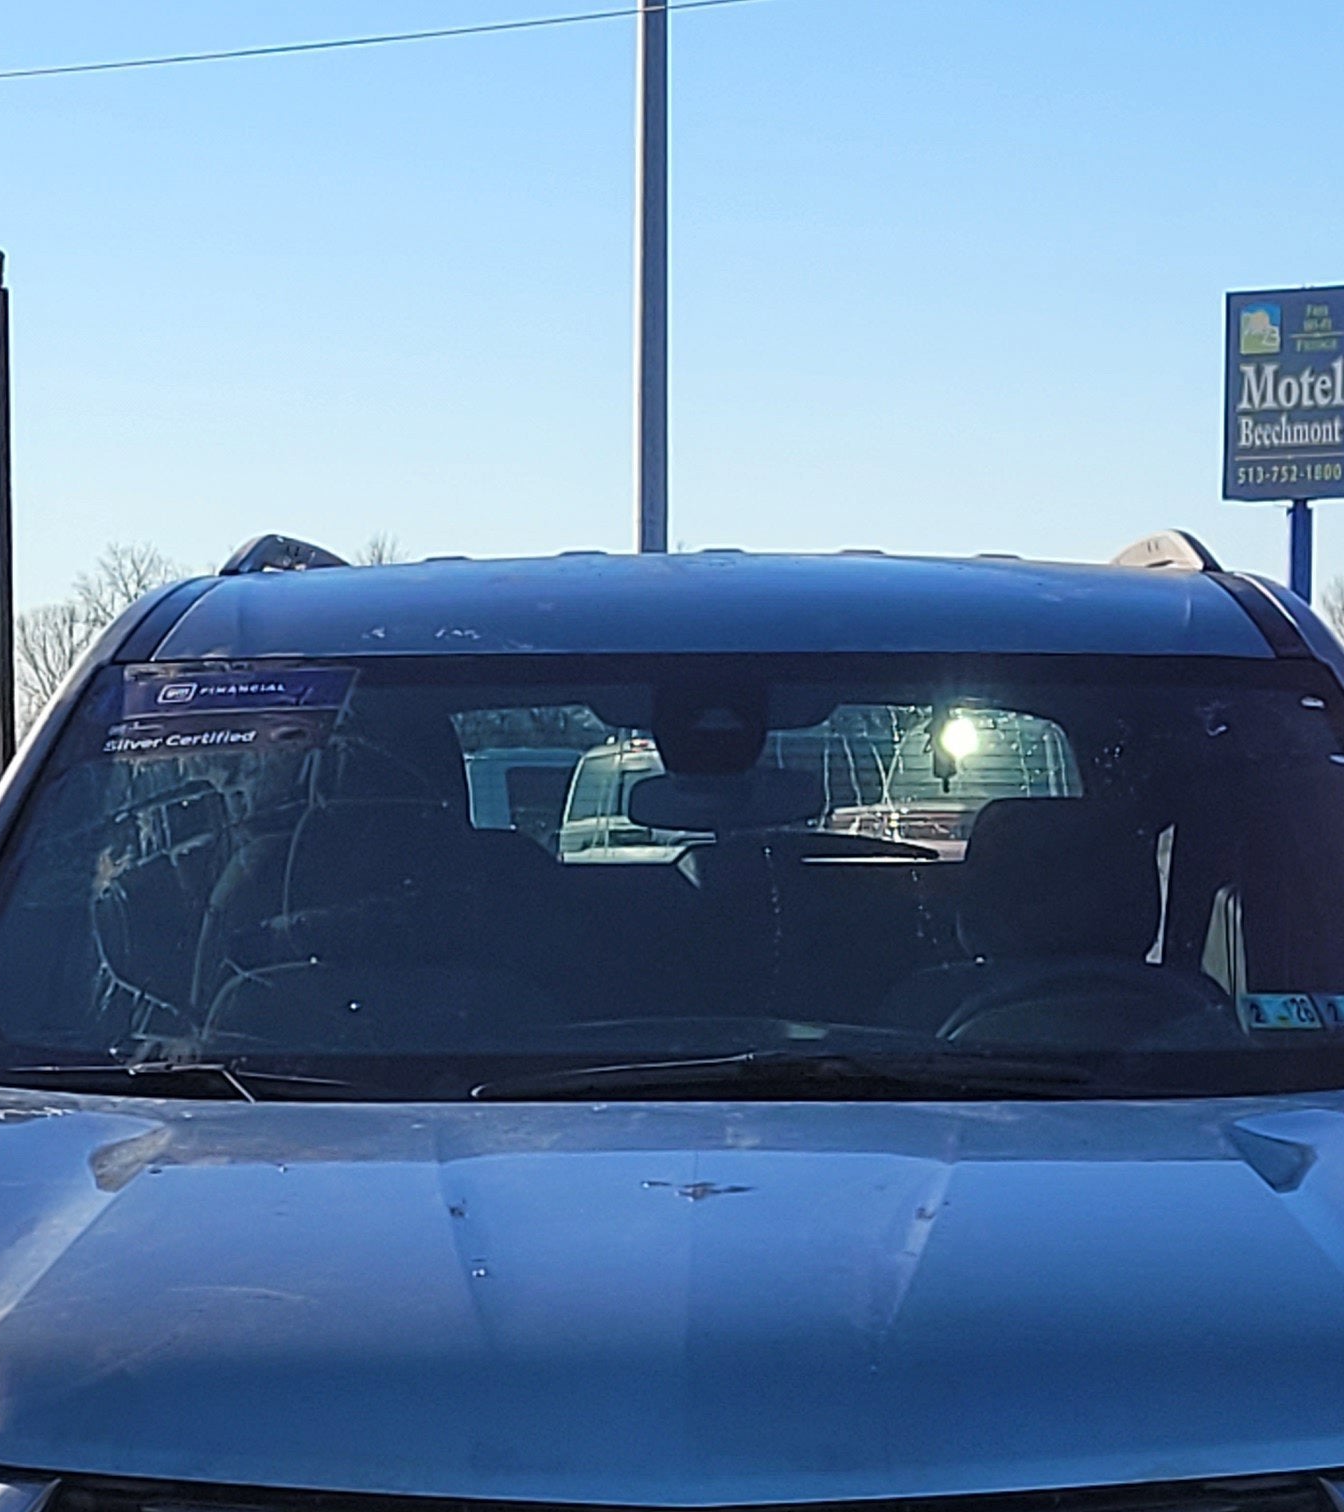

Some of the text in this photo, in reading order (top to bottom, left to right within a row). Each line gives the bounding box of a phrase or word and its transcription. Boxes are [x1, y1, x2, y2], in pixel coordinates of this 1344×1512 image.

[1239, 412, 1343, 446] Beechmont
[104, 730, 257, 752] Silver Certified
